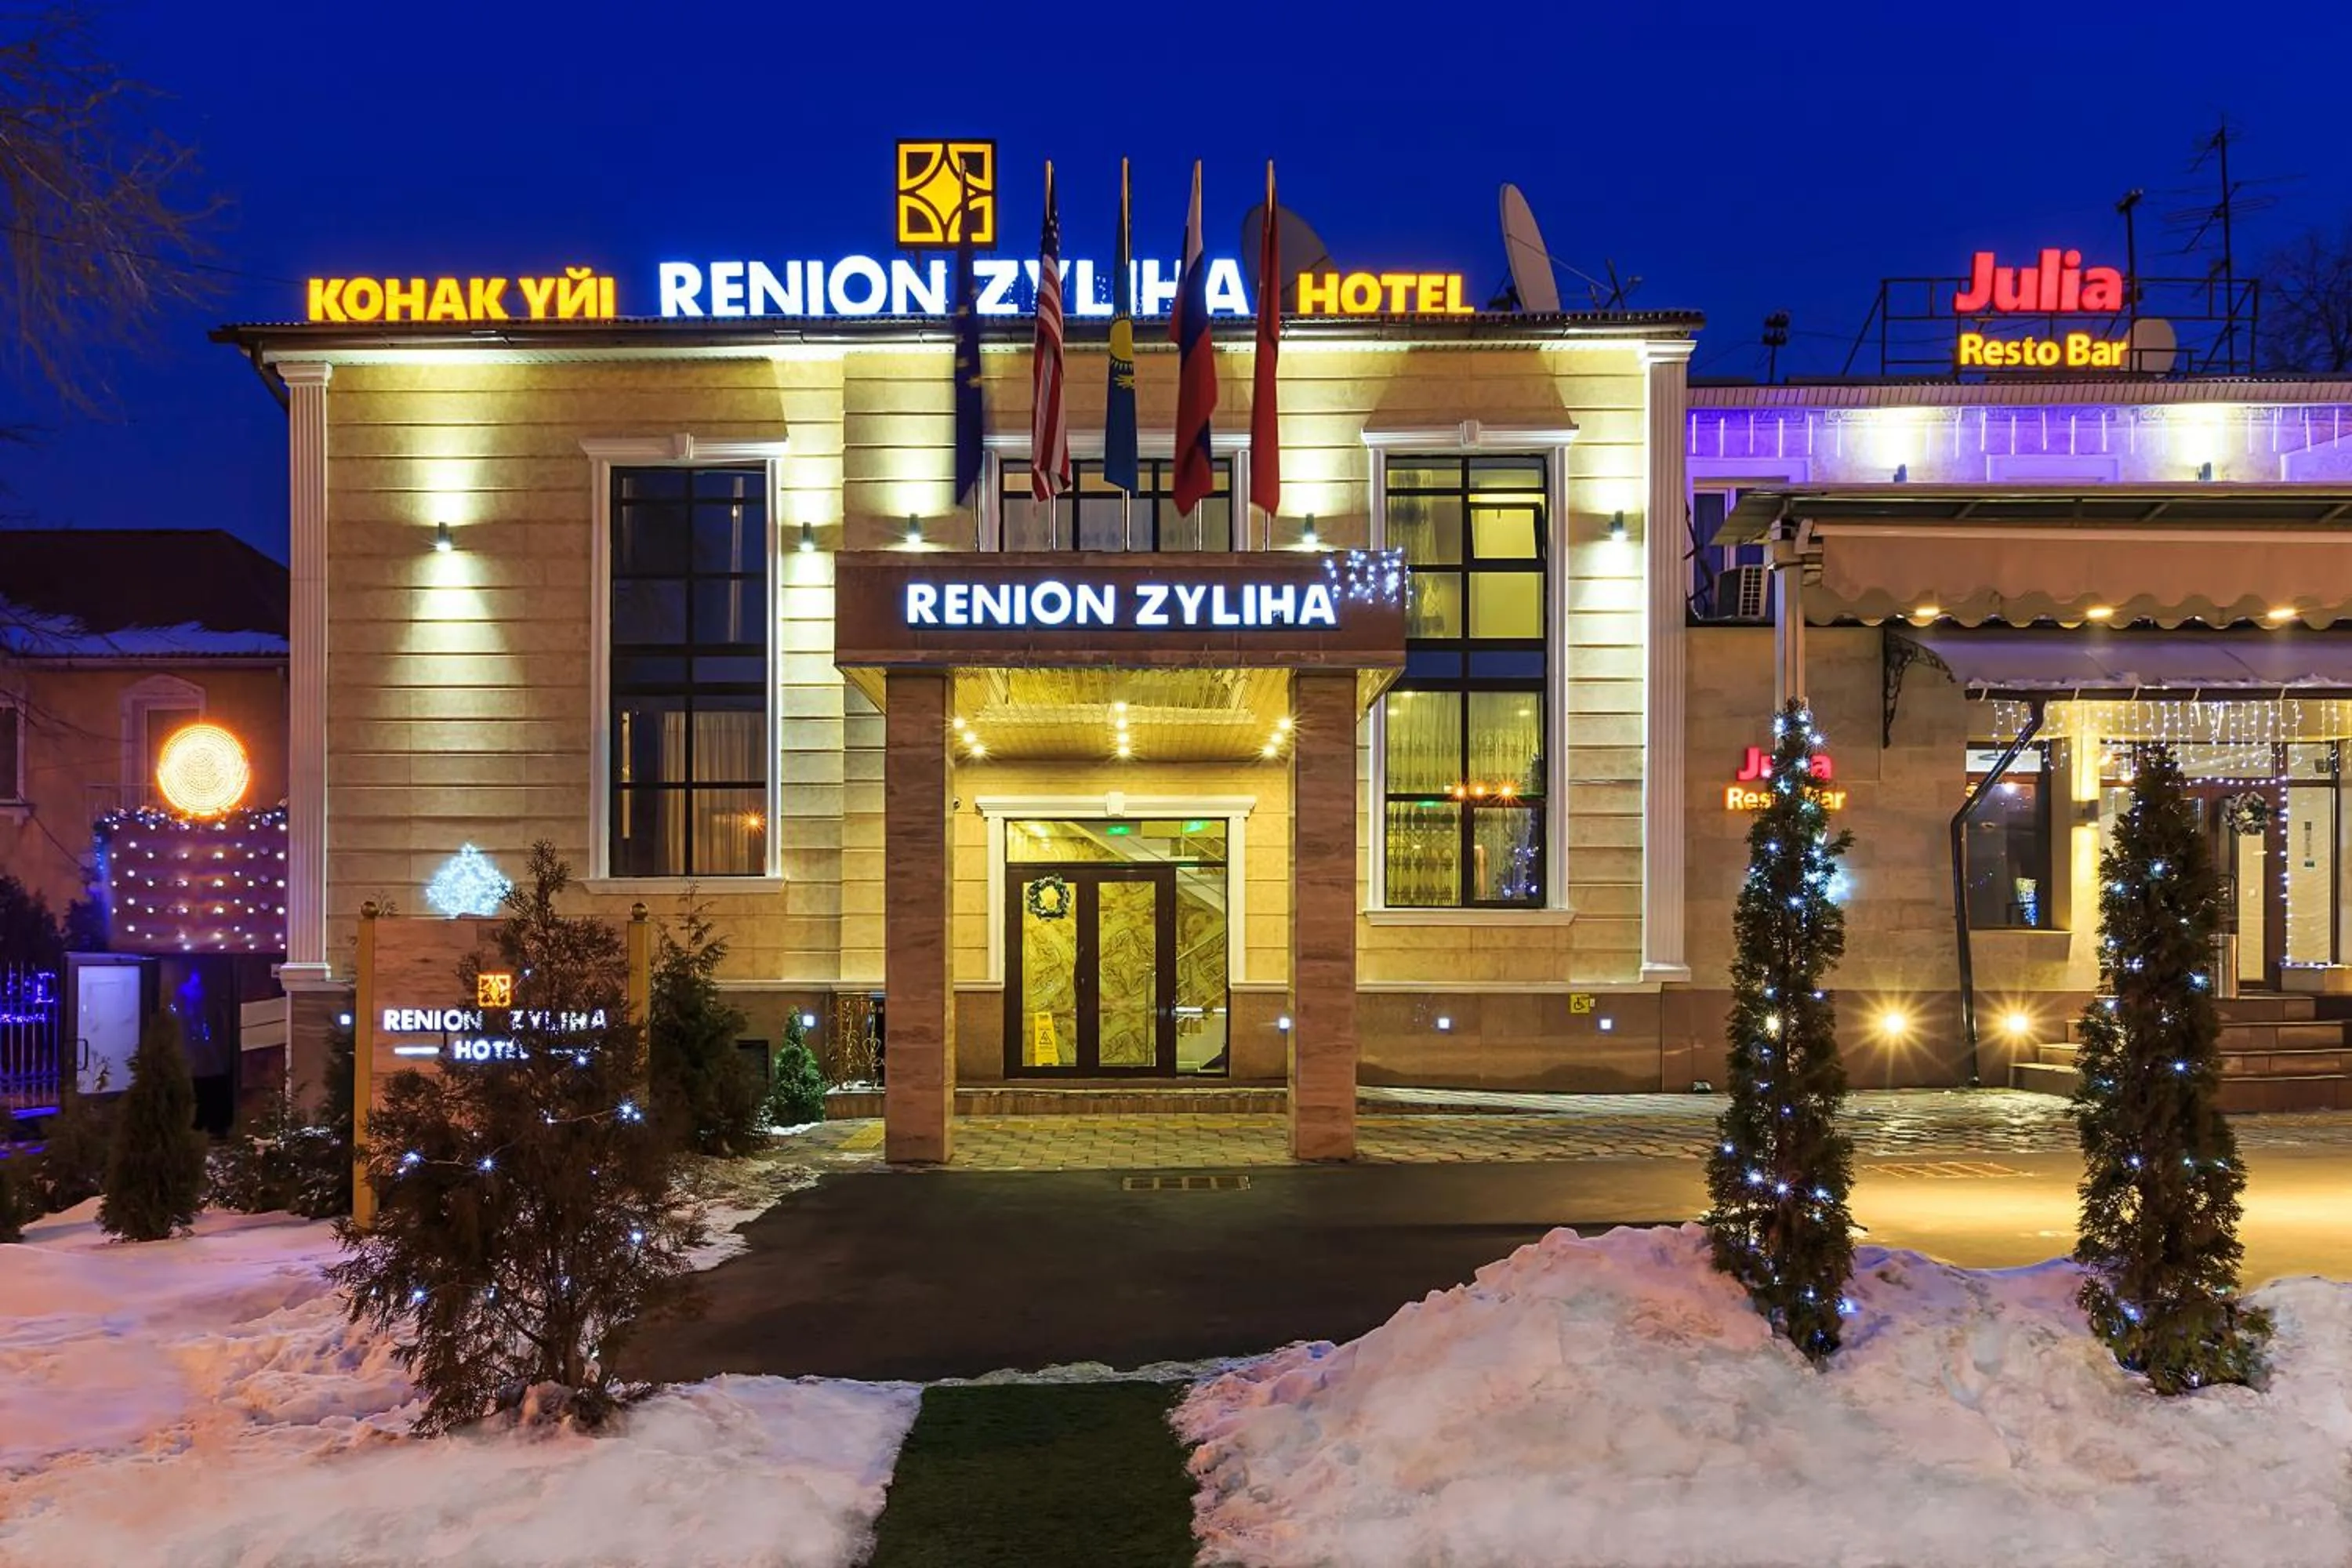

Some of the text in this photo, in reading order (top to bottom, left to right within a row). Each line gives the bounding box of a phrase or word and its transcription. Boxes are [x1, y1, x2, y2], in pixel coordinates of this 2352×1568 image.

[659, 255, 947, 317] RENION
[1298, 271, 1475, 314] HOTEL
[1955, 249, 2123, 312] Julia
[1960, 333, 2128, 366] Resto Bar
[906, 581, 1336, 625] RENION ZYLIHA
[383, 1009, 482, 1031] RENION
[454, 1040, 529, 1060] HOTEL
